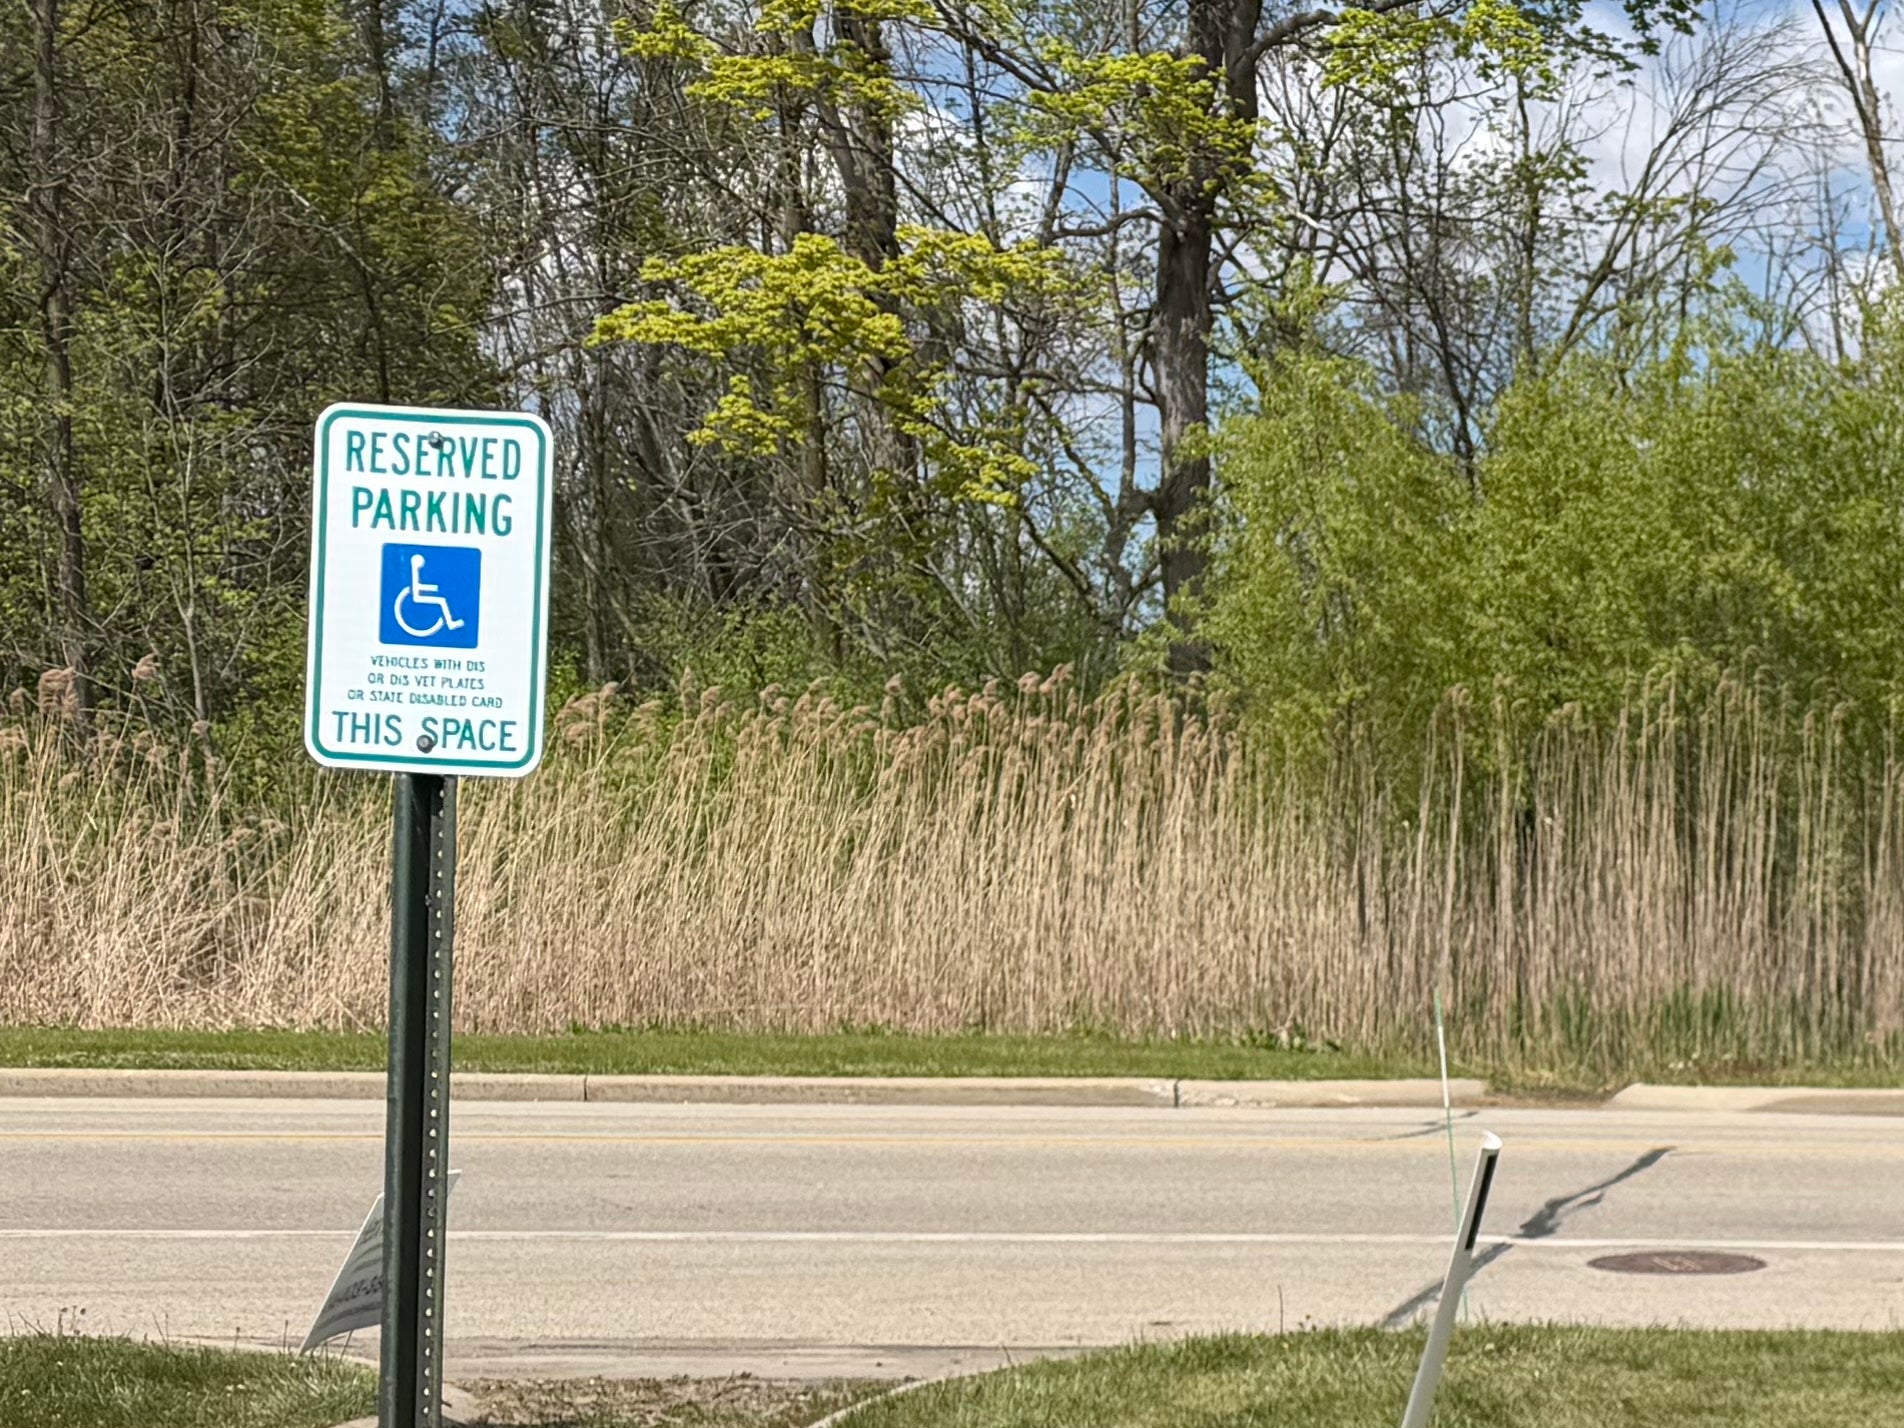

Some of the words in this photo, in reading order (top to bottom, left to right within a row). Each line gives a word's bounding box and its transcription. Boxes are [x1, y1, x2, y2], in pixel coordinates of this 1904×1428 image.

[345, 429, 522, 480] RESERVED
[351, 486, 513, 537] PARKING
[370, 655, 429, 669] VEHICLES
[434, 658, 461, 671] WITH
[466, 660, 486, 673] DIS
[367, 672, 385, 685] OR
[389, 673, 410, 687] DIS
[414, 675, 436, 688] VET
[441, 676, 486, 690] PLATES
[347, 689, 365, 701] OR
[369, 690, 404, 704] STATE
[409, 692, 467, 707] DISABLED
[471, 696, 504, 709] CARD
[332, 710, 403, 747] THIS
[420, 715, 518, 752] SPACE
